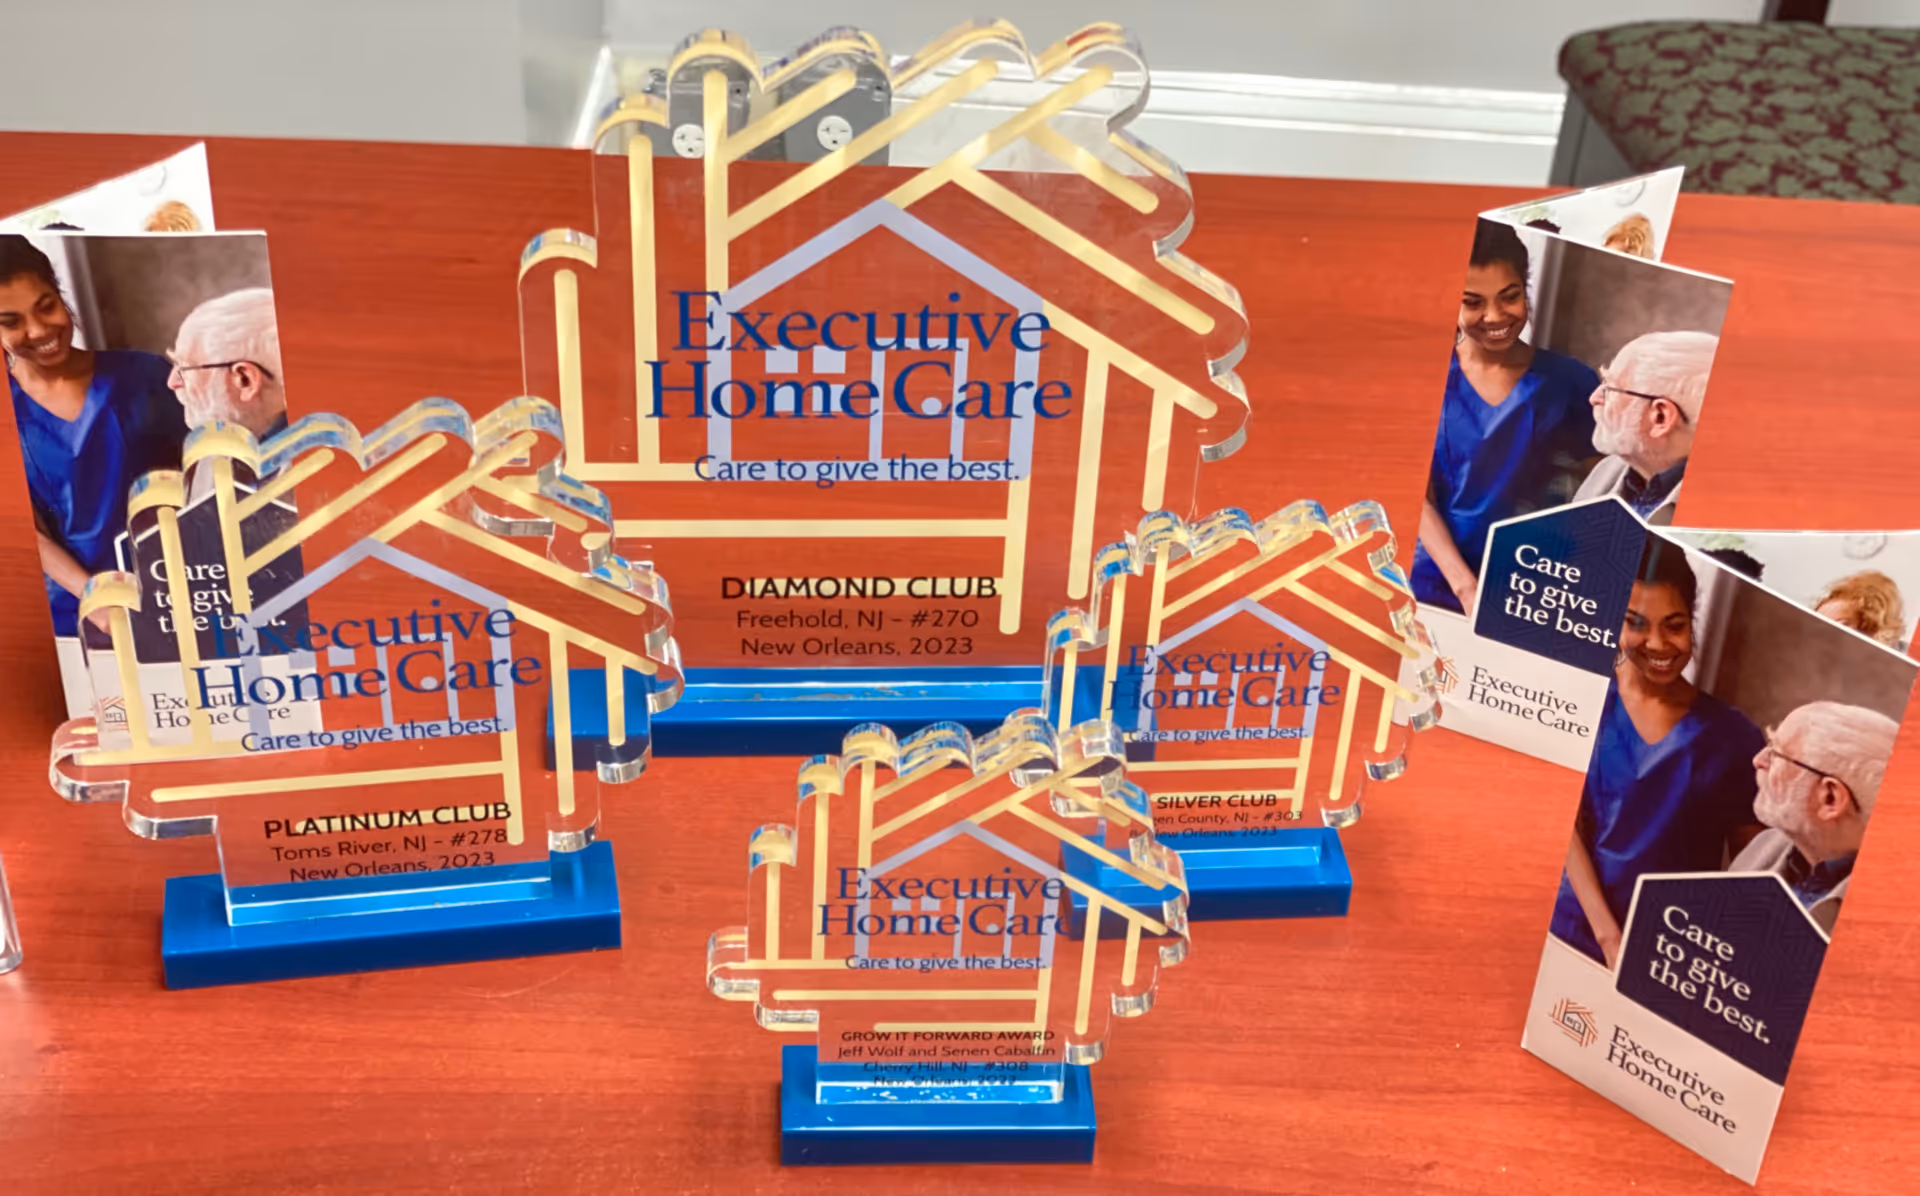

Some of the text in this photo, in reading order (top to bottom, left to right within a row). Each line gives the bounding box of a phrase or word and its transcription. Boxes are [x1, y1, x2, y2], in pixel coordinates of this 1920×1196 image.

[671, 291, 1051, 352] Executive
[694, 454, 1020, 488] Care to give the best.
[1514, 544, 1582, 584] Care
[193, 583, 254, 612] giv
[721, 577, 997, 599] DIAMOND CLUB
[1509, 572, 1598, 616] to give
[208, 599, 517, 659] Executive
[737, 609, 849, 630] Freehold,
[858, 610, 883, 631] NJ
[910, 610, 979, 628] #270
[1504, 595, 1617, 649] the best.
[741, 637, 972, 657] New Orleans, 2023
[1125, 642, 1332, 676] Executive
[1471, 665, 1578, 715] Executive
[241, 716, 508, 752] Care to give the best.
[1129, 725, 1308, 744] Care to give the best.
[1156, 794, 1277, 809] SILVER CLUB
[1234, 813, 1249, 823] NJ
[264, 802, 512, 839] PLATINUM CLUB
[271, 846, 332, 862] Toms
[338, 840, 397, 856] River,
[404, 835, 427, 852] NJ
[450, 829, 507, 846] #278
[289, 852, 495, 883] New Orleans, 2023
[836, 867, 1065, 900] Executive
[1663, 906, 1735, 962] Care
[845, 954, 1046, 973] Care to give the best.
[1655, 933, 1752, 1001] to give
[1649, 959, 1770, 1044] the best.
[841, 1031, 1054, 1041] GROW IT FORWARD AWARD
[868, 1045, 903, 1057] Wolf
[908, 1046, 936, 1057] and
[941, 1046, 990, 1057] Senen
[1609, 1025, 1725, 1106] Executive
